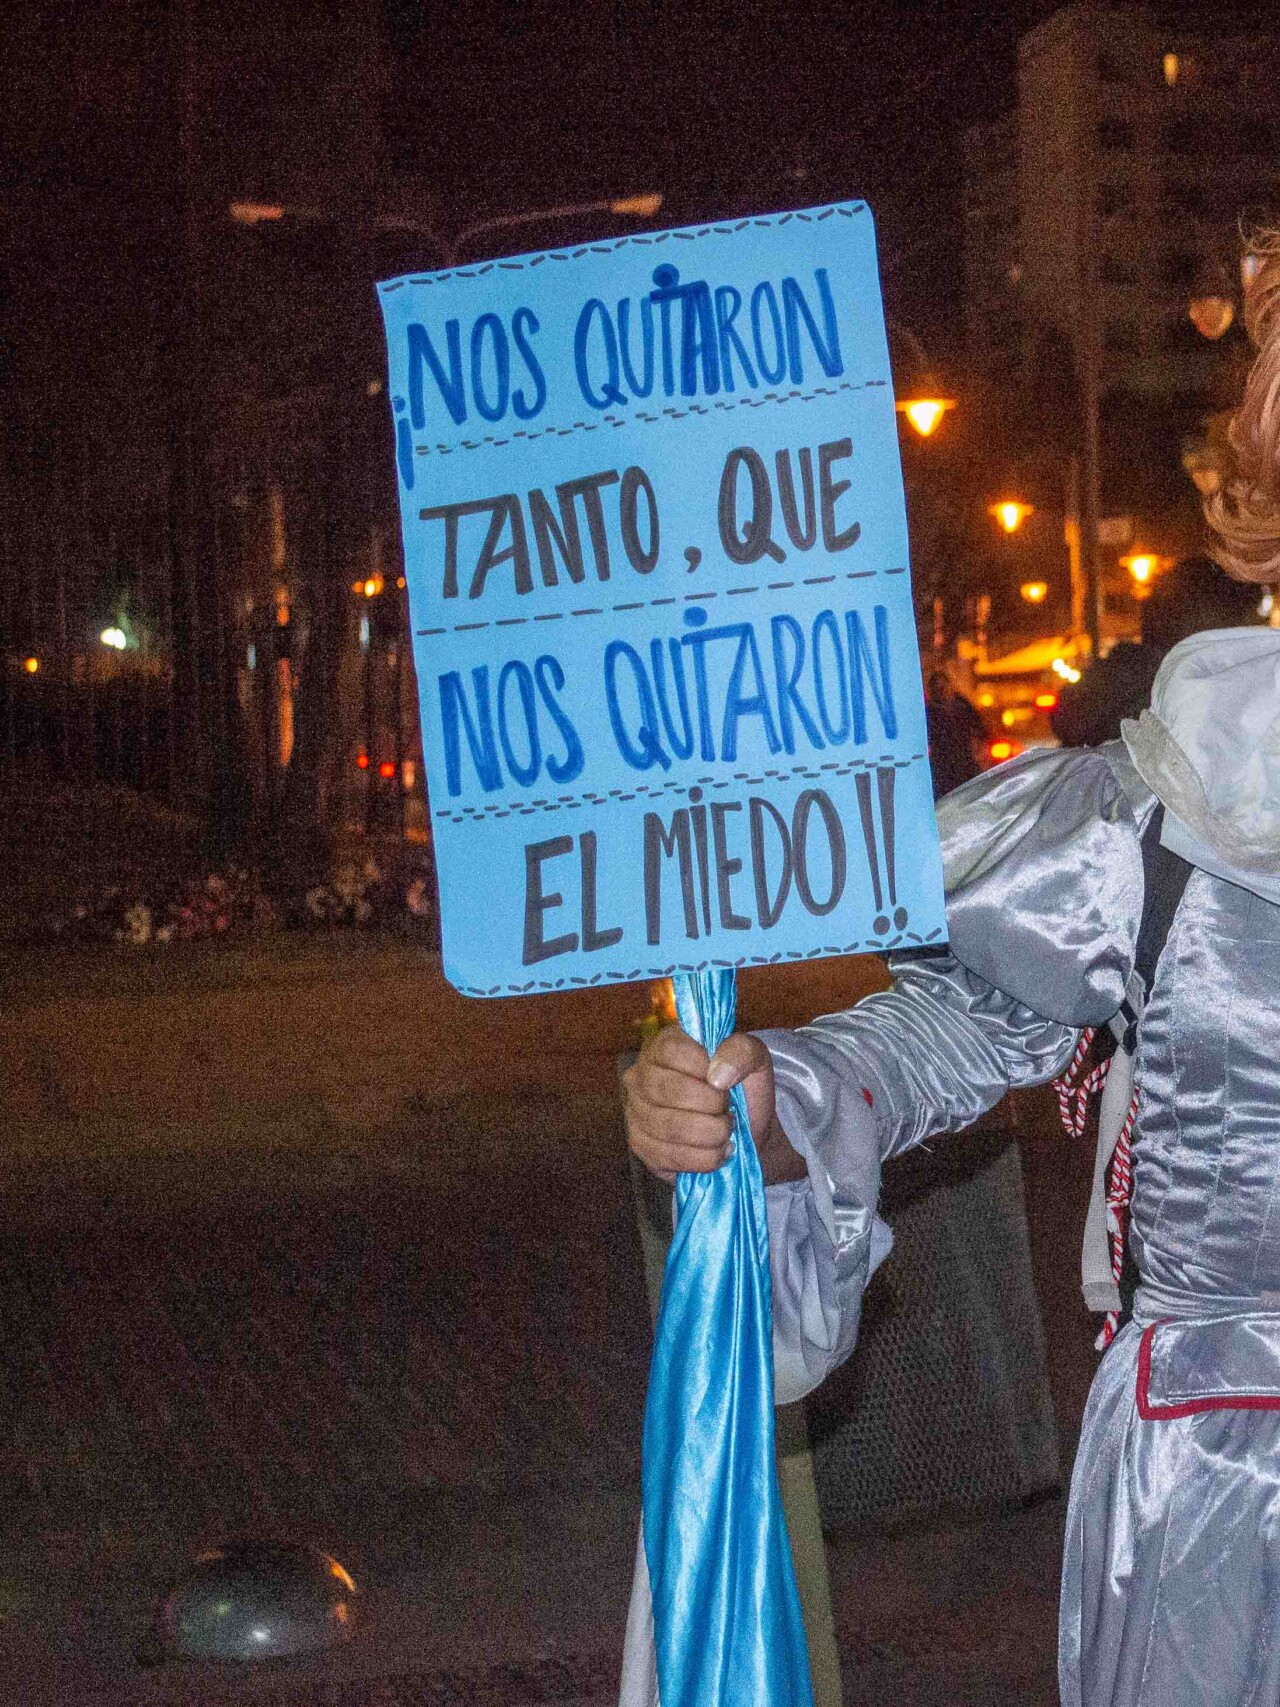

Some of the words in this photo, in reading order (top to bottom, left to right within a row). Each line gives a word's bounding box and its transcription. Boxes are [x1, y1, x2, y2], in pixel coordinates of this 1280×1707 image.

[419, 465, 703, 600] TANTO,
[717, 437, 861, 566] QUE
[438, 654, 586, 797] NOS
[521, 830, 624, 967] EL
